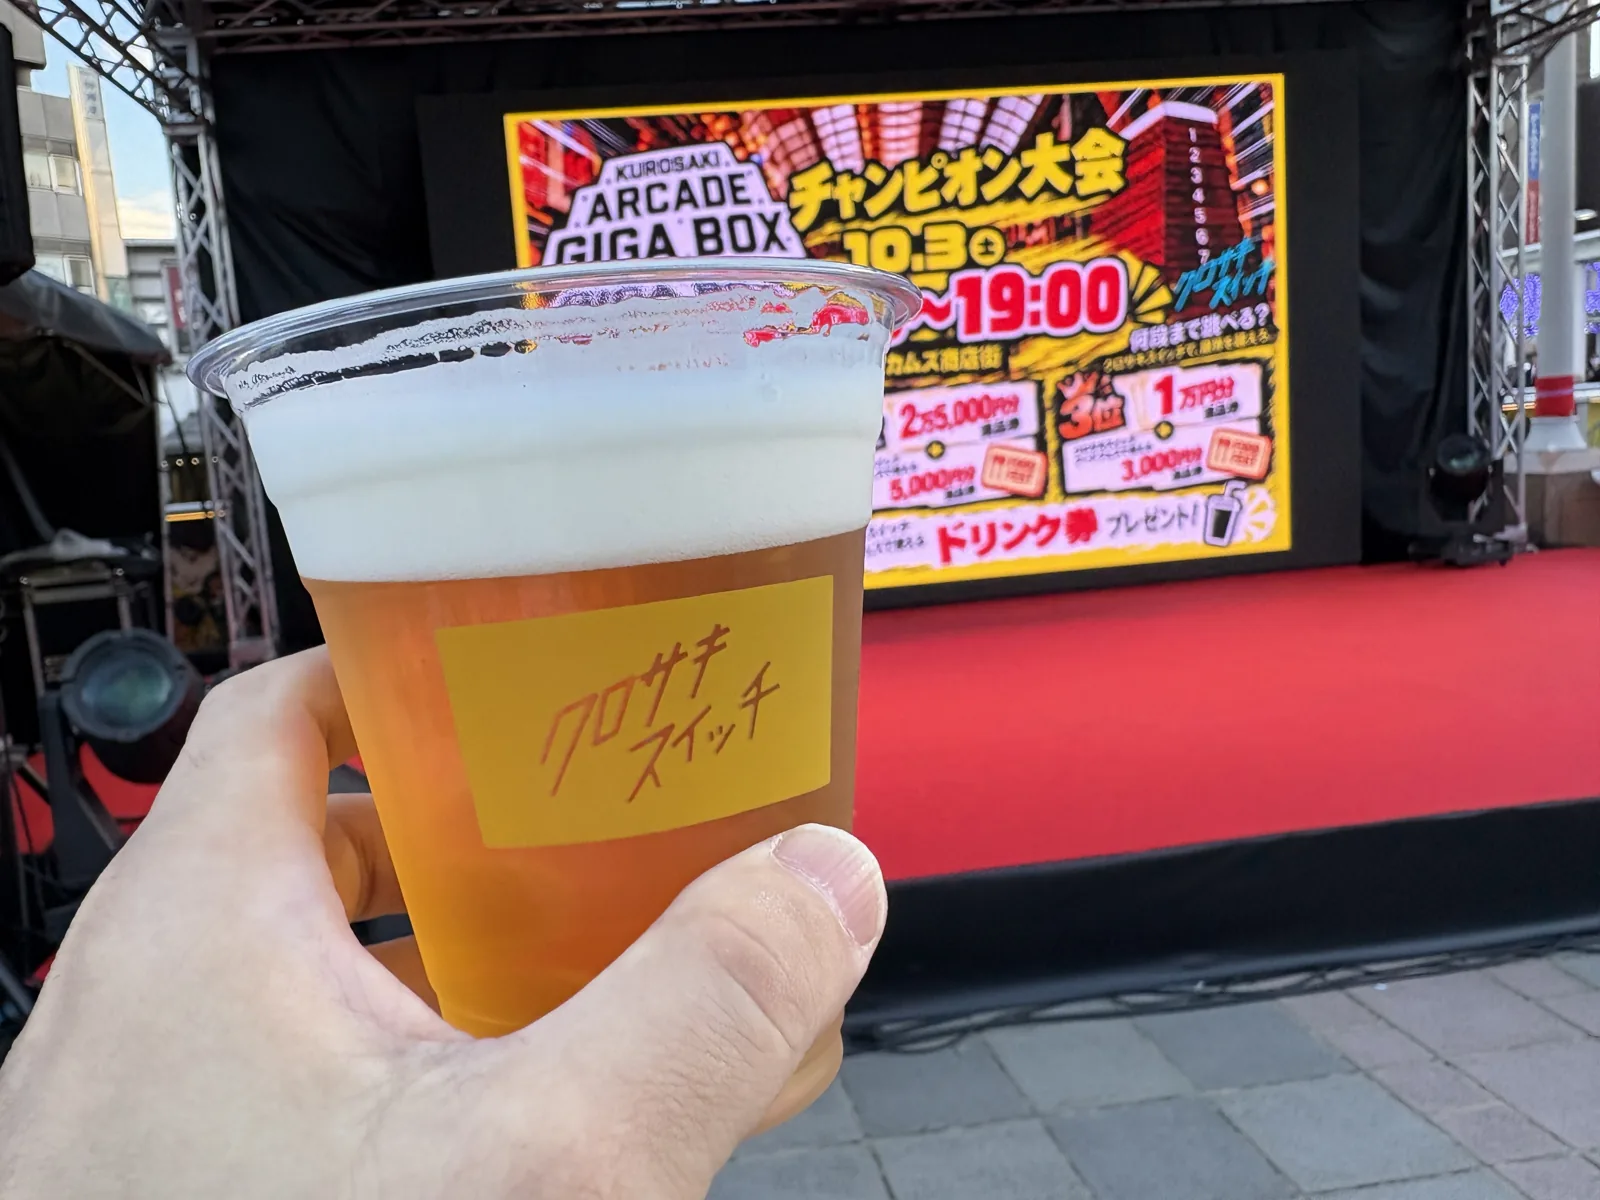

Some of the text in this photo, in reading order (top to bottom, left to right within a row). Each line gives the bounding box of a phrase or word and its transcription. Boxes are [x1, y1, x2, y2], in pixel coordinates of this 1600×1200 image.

[1188, 127, 1198, 143] 1
[615, 149, 721, 182] KUROSAKI
[1189, 146, 1201, 164] 2
[789, 127, 1127, 231] チャンピオン大会
[1190, 166, 1204, 185] 3
[587, 172, 753, 226] ARCADE
[1192, 187, 1206, 204] 4
[1194, 207, 1207, 225] 5
[555, 211, 789, 265] GIGA BOX
[1195, 227, 1210, 246] 6
[1058, 394, 1125, 440] 3位
[540, 623, 731, 798] クロサキ
[627, 660, 781, 804] スイッチ
